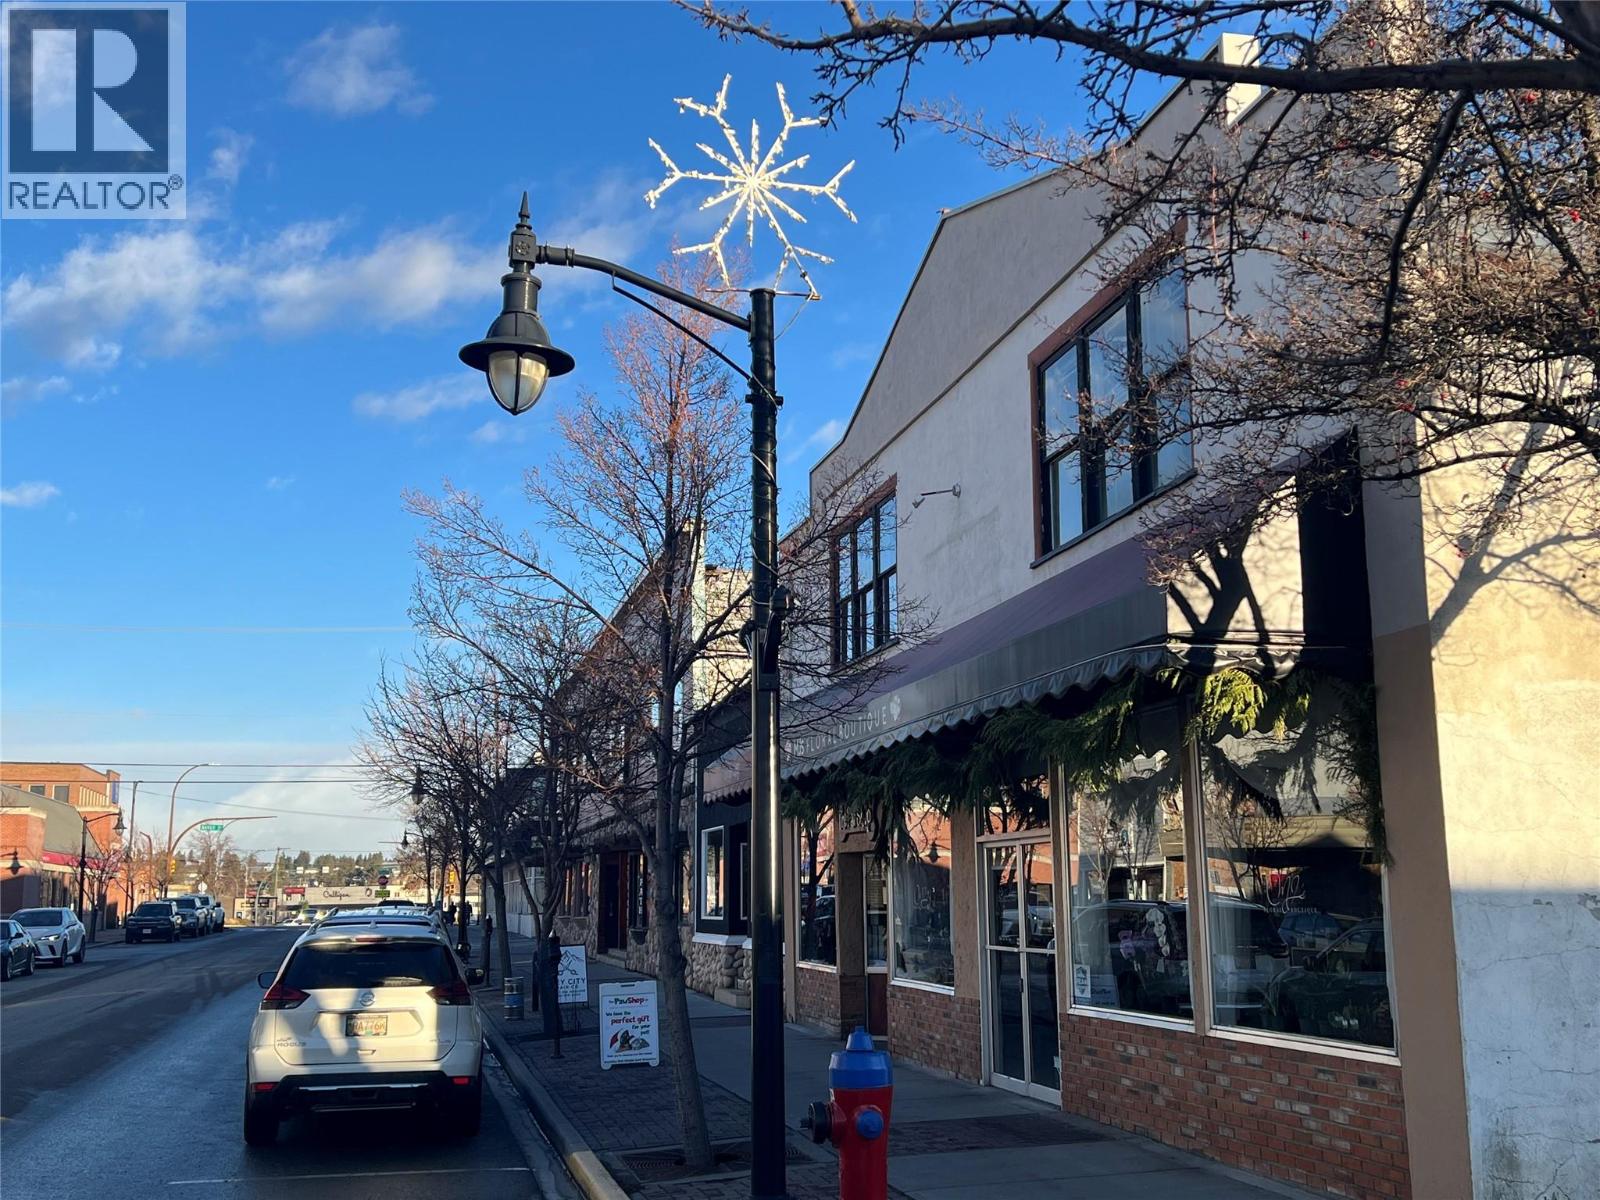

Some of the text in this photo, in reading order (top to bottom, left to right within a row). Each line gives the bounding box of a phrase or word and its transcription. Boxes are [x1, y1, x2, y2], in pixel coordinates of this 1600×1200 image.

[322, 889, 351, 900] Culligan
[614, 996, 645, 1005] PawShop
[611, 1015, 650, 1025] perfect gift
